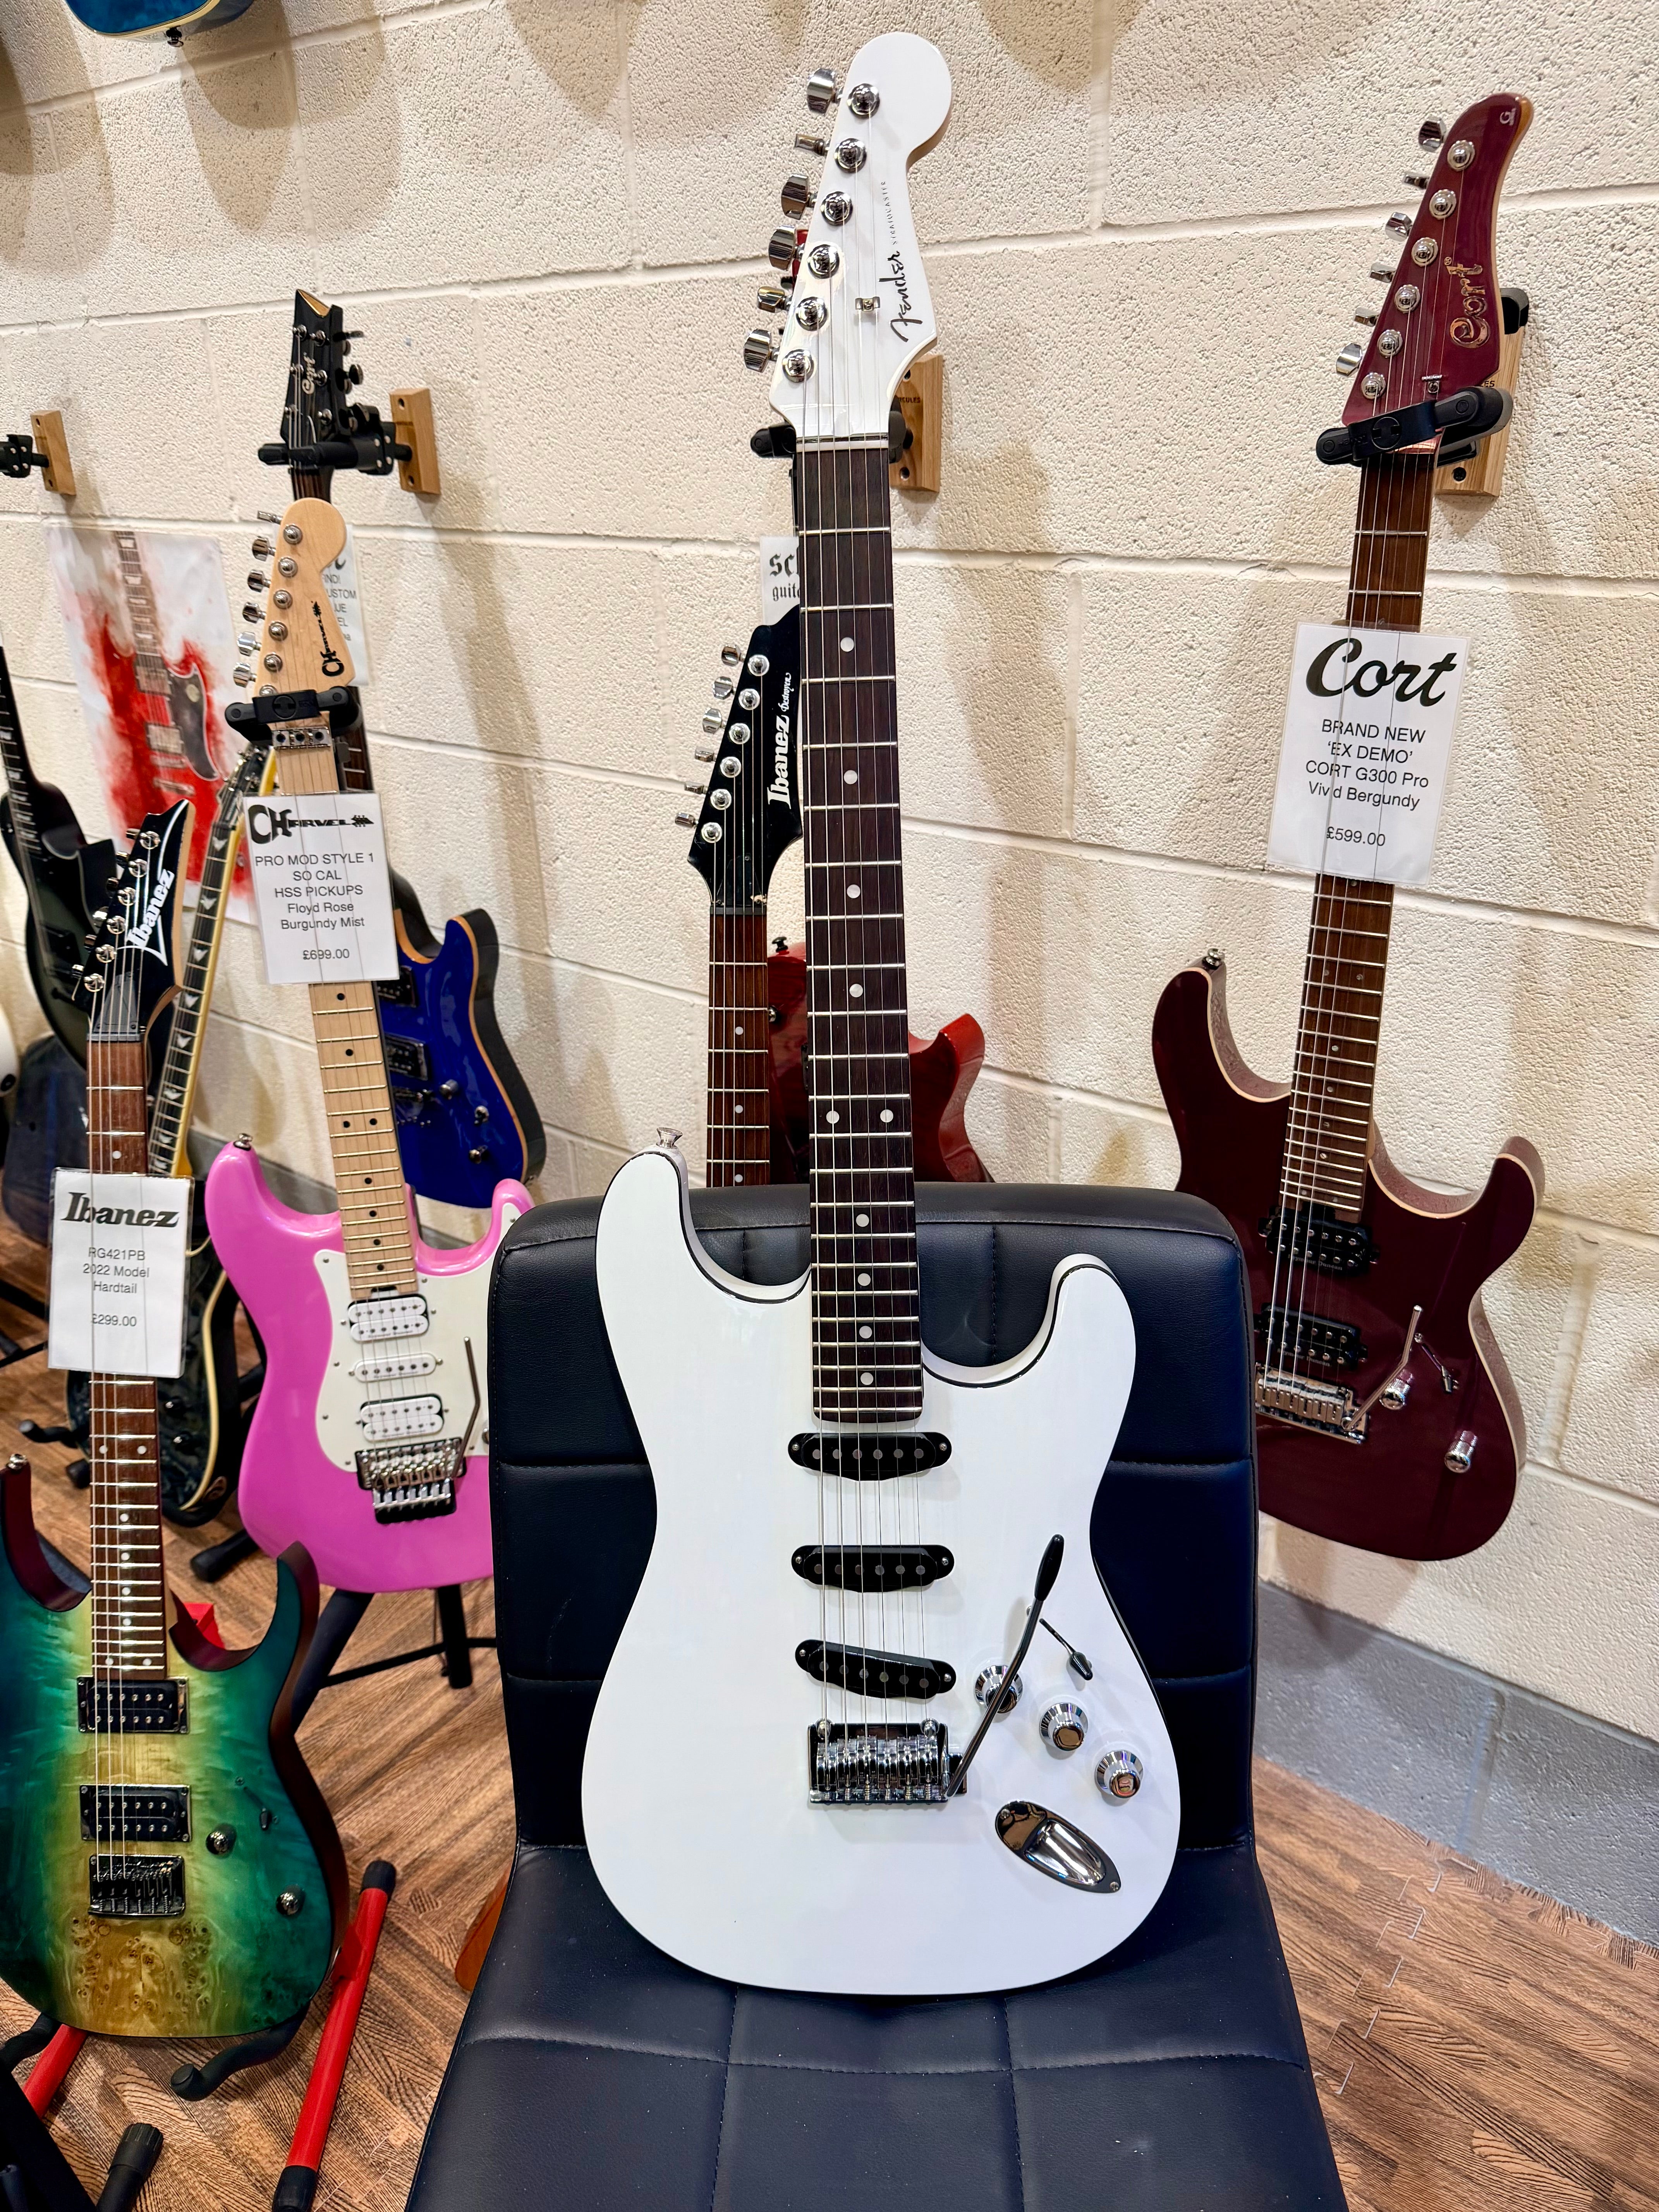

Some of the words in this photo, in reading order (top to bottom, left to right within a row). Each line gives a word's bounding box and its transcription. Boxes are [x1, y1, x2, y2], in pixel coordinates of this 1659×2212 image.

[878, 250, 923, 342] Fender
[326, 588, 357, 599] USTOM
[1306, 638, 1457, 707] Cort
[778, 672, 794, 712] Destroyer
[1321, 719, 1379, 738] BRAND
[1384, 726, 1426, 743] NEW
[767, 715, 791, 809] Ibanez
[1305, 760, 1351, 778] CORT
[1355, 767, 1397, 785] G300
[1402, 774, 1429, 788] Pro
[1308, 781, 1343, 799] Vivd
[1346, 787, 1420, 811] Bergundy
[1326, 826, 1386, 847] £599.00
[255, 855, 284, 867] PRO
[288, 854, 319, 866] MOD
[322, 853, 364, 865] STYLE
[369, 853, 374, 863] 1
[293, 871, 312, 881] SO
[316, 870, 342, 881] CAL
[275, 887, 302, 898] HSS
[306, 885, 364, 897] PICKUPS
[126, 869, 175, 948] Ibanez
[288, 902, 320, 915] Floyd
[324, 902, 354, 912] Rose
[281, 919, 337, 931] Burgundy
[341, 917, 365, 927] Mist
[303, 948, 350, 960] £699.00
[61, 1192, 180, 1228] Ibanez
[89, 1247, 146, 1261] RG421PB
[83, 1263, 110, 1276] 2022
[114, 1265, 150, 1278] Model
[94, 1281, 137, 1294] Hardtail
[93, 1314, 137, 1327] £299.00
